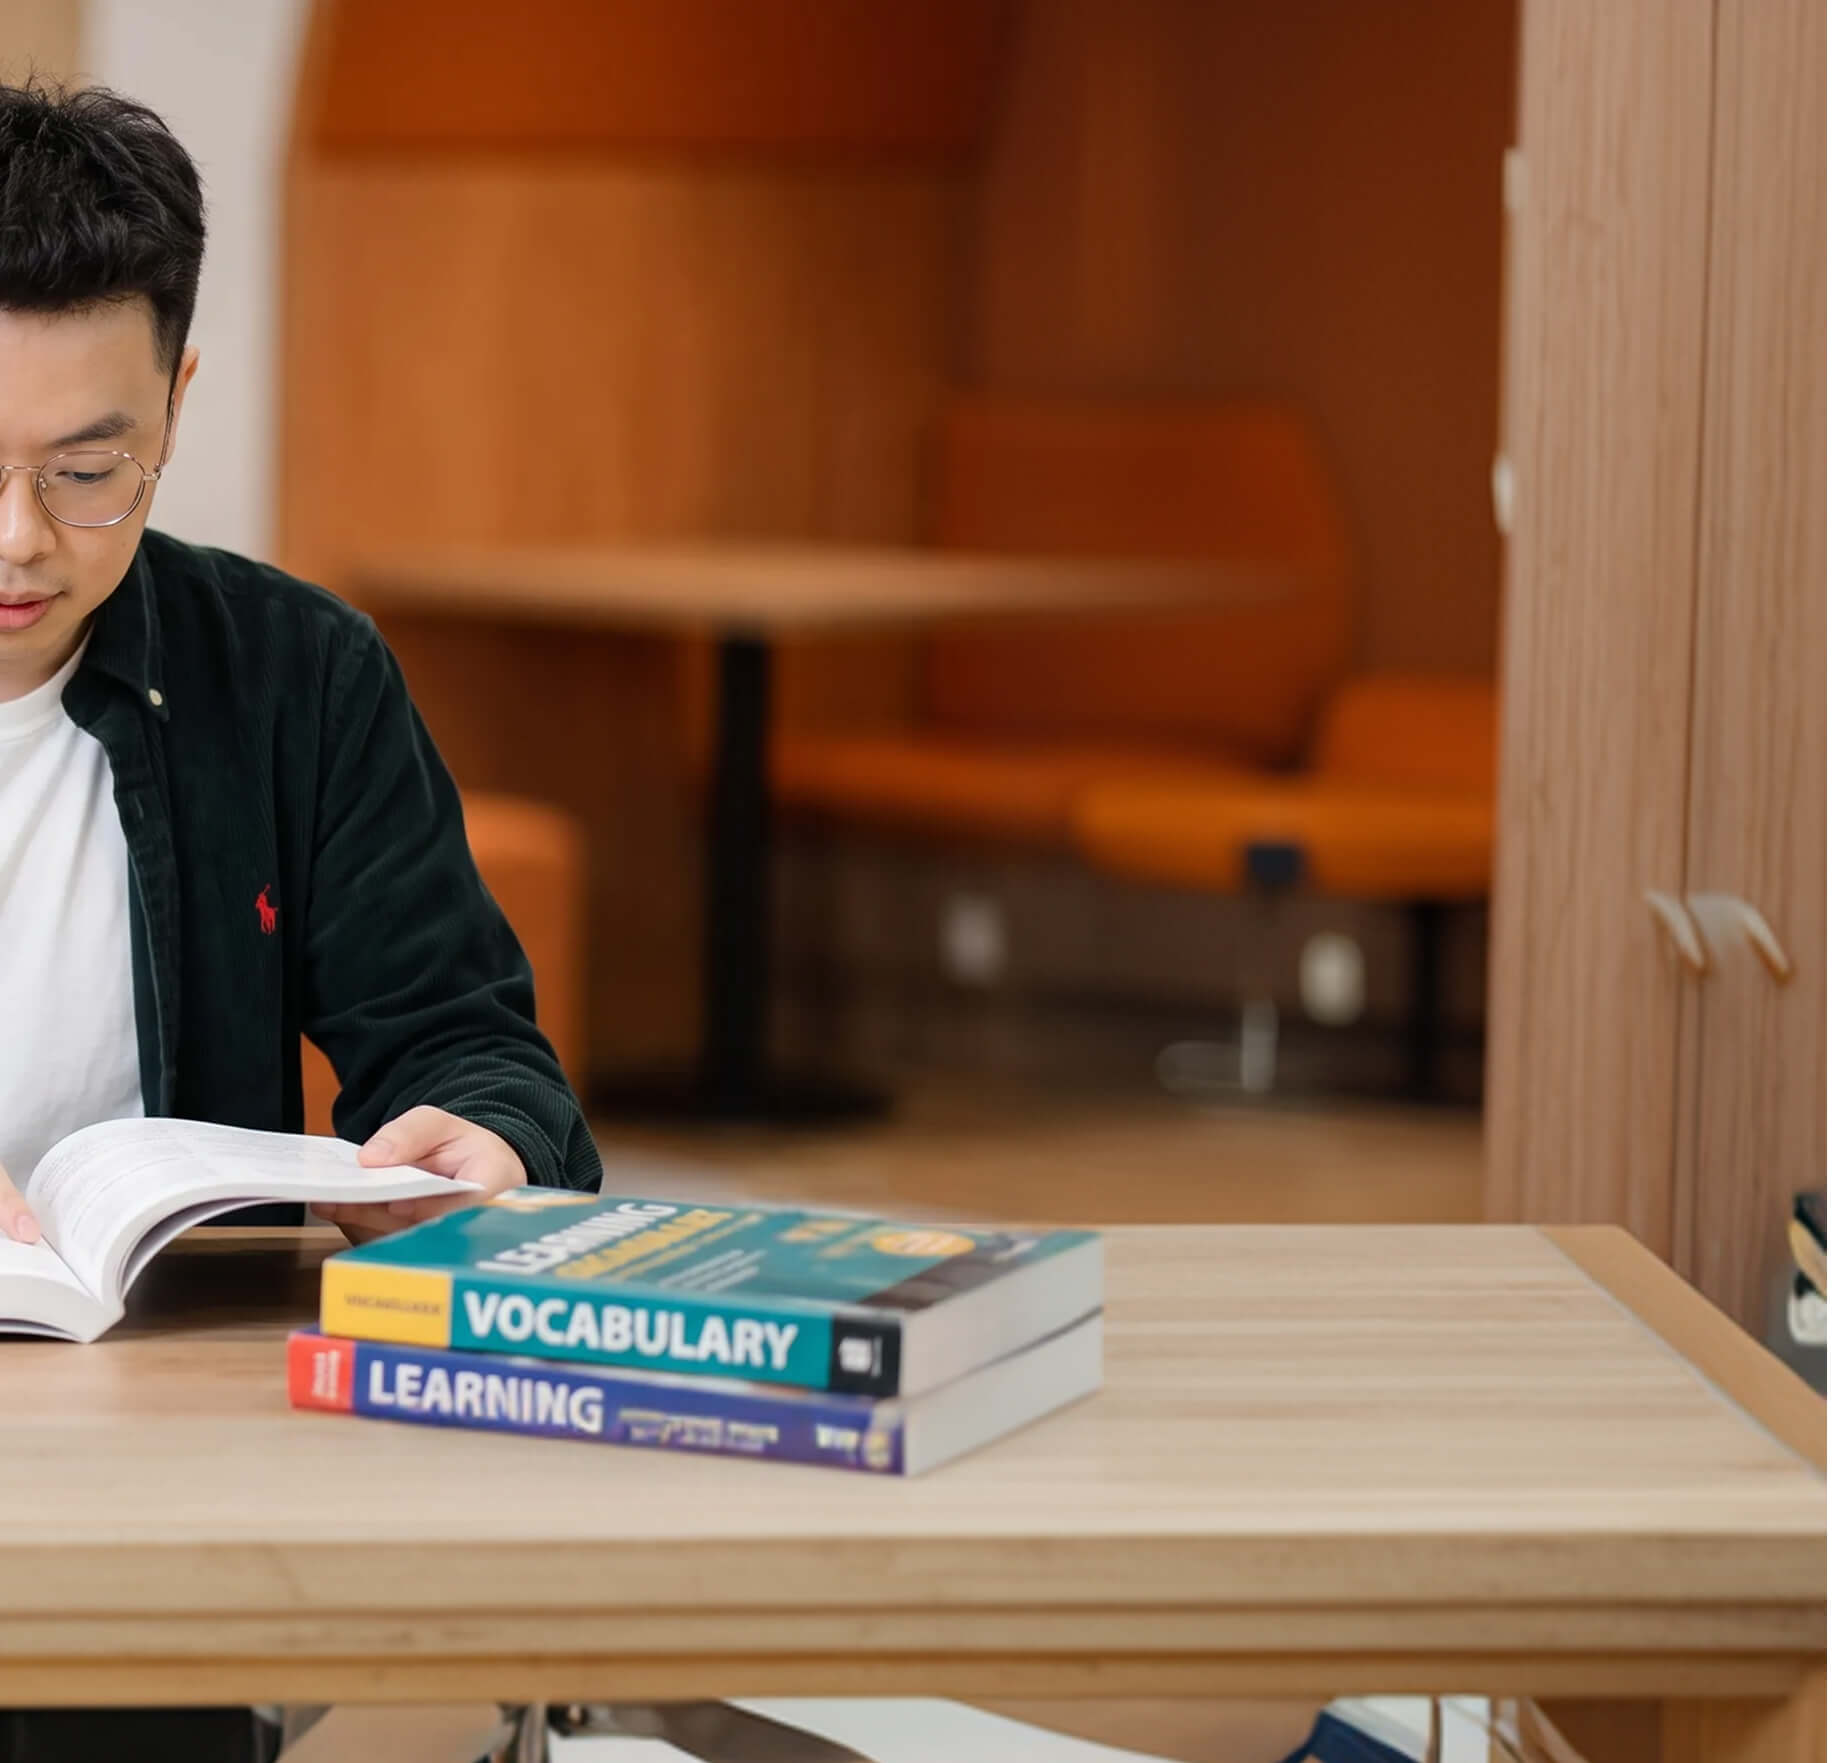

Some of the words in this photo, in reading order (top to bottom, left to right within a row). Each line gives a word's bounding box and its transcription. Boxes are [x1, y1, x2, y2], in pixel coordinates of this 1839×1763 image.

[476, 1203, 678, 1275] LEARNING
[463, 1290, 799, 1370] VOCABULARY
[368, 1360, 604, 1433] LEARNING
